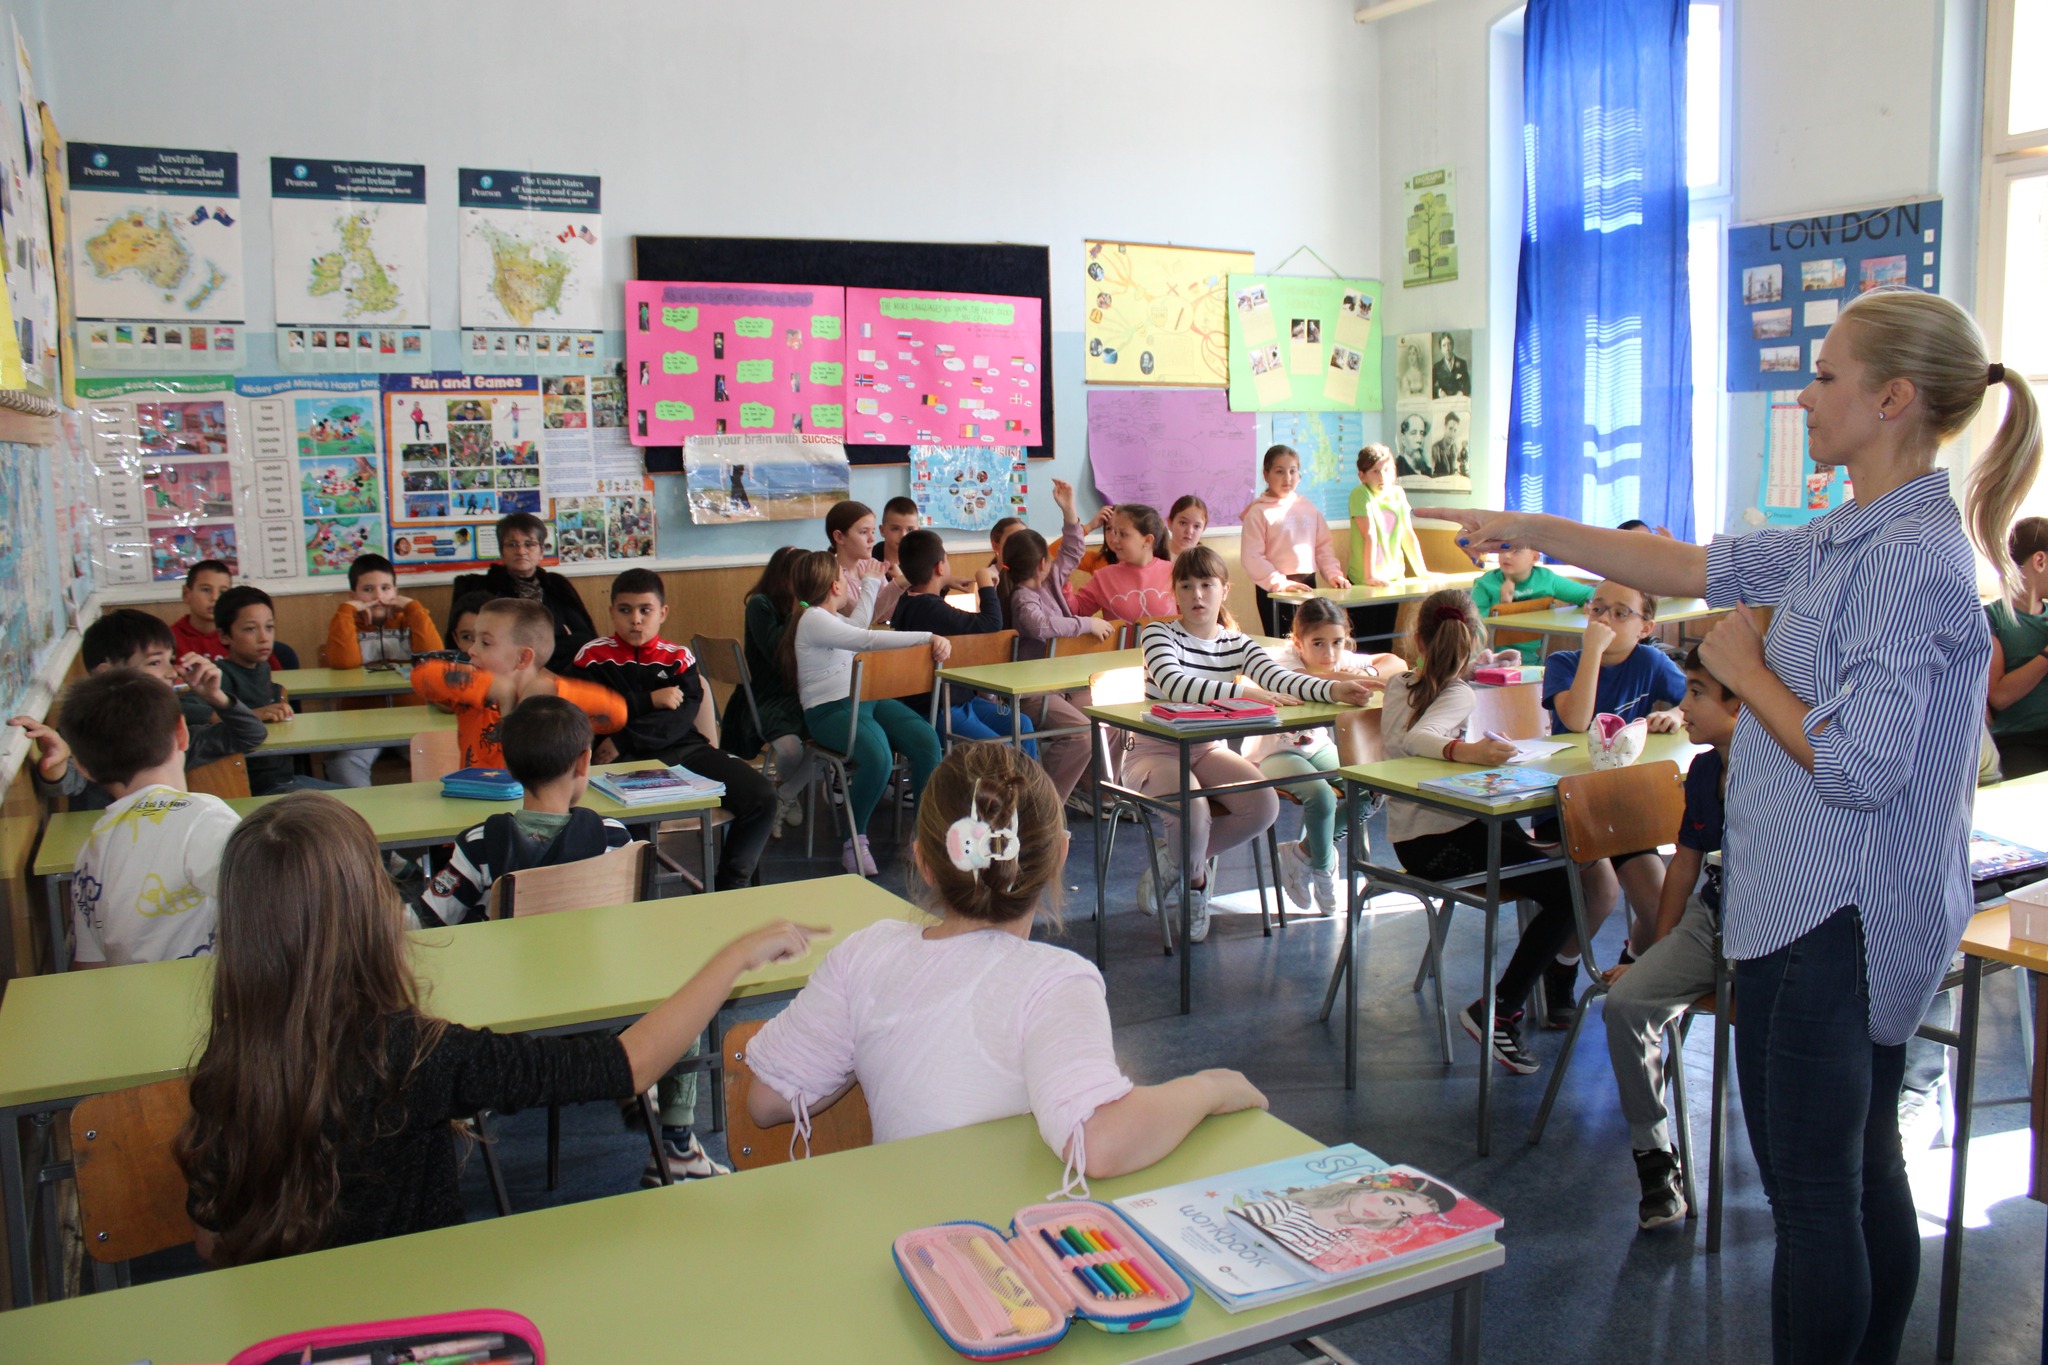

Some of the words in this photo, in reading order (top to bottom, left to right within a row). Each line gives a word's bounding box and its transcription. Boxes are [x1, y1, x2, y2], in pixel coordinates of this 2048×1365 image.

[158, 153, 204, 165] Australia
[83, 166, 120, 177] Pearson
[137, 165, 157, 175] and
[159, 166, 181, 176] New
[184, 167, 225, 179] Zealand
[332, 165, 348, 174] The
[377, 166, 413, 178] Kingdom
[175, 178, 205, 186] Speaking
[285, 177, 318, 188] Pearson
[350, 176, 366, 185] and
[367, 176, 396, 186] Ireland
[521, 176, 536, 185] The
[536, 176, 561, 187] United
[562, 178, 584, 188] States
[471, 188, 502, 198] Pearson
[511, 185, 520, 193] of
[521, 186, 550, 195] America
[551, 187, 566, 196] and
[566, 188, 595, 198] Canada
[547, 196, 572, 205] Speaking
[1769, 203, 1921, 251] LONDON
[87, 387, 124, 397] Getting
[174, 380, 226, 391] everland
[241, 383, 272, 394] Mickey
[273, 381, 291, 391] and
[293, 379, 329, 389] Minnie's
[331, 380, 359, 390] Happy
[360, 379, 379, 388] Day
[410, 375, 439, 389] Fun
[441, 375, 471, 389] and
[473, 375, 523, 389] Games
[718, 435, 741, 447] your
[744, 434, 772, 445] brain
[775, 434, 799, 444] with
[802, 434, 844, 445] success
[1179, 1204, 1271, 1267] workbook
